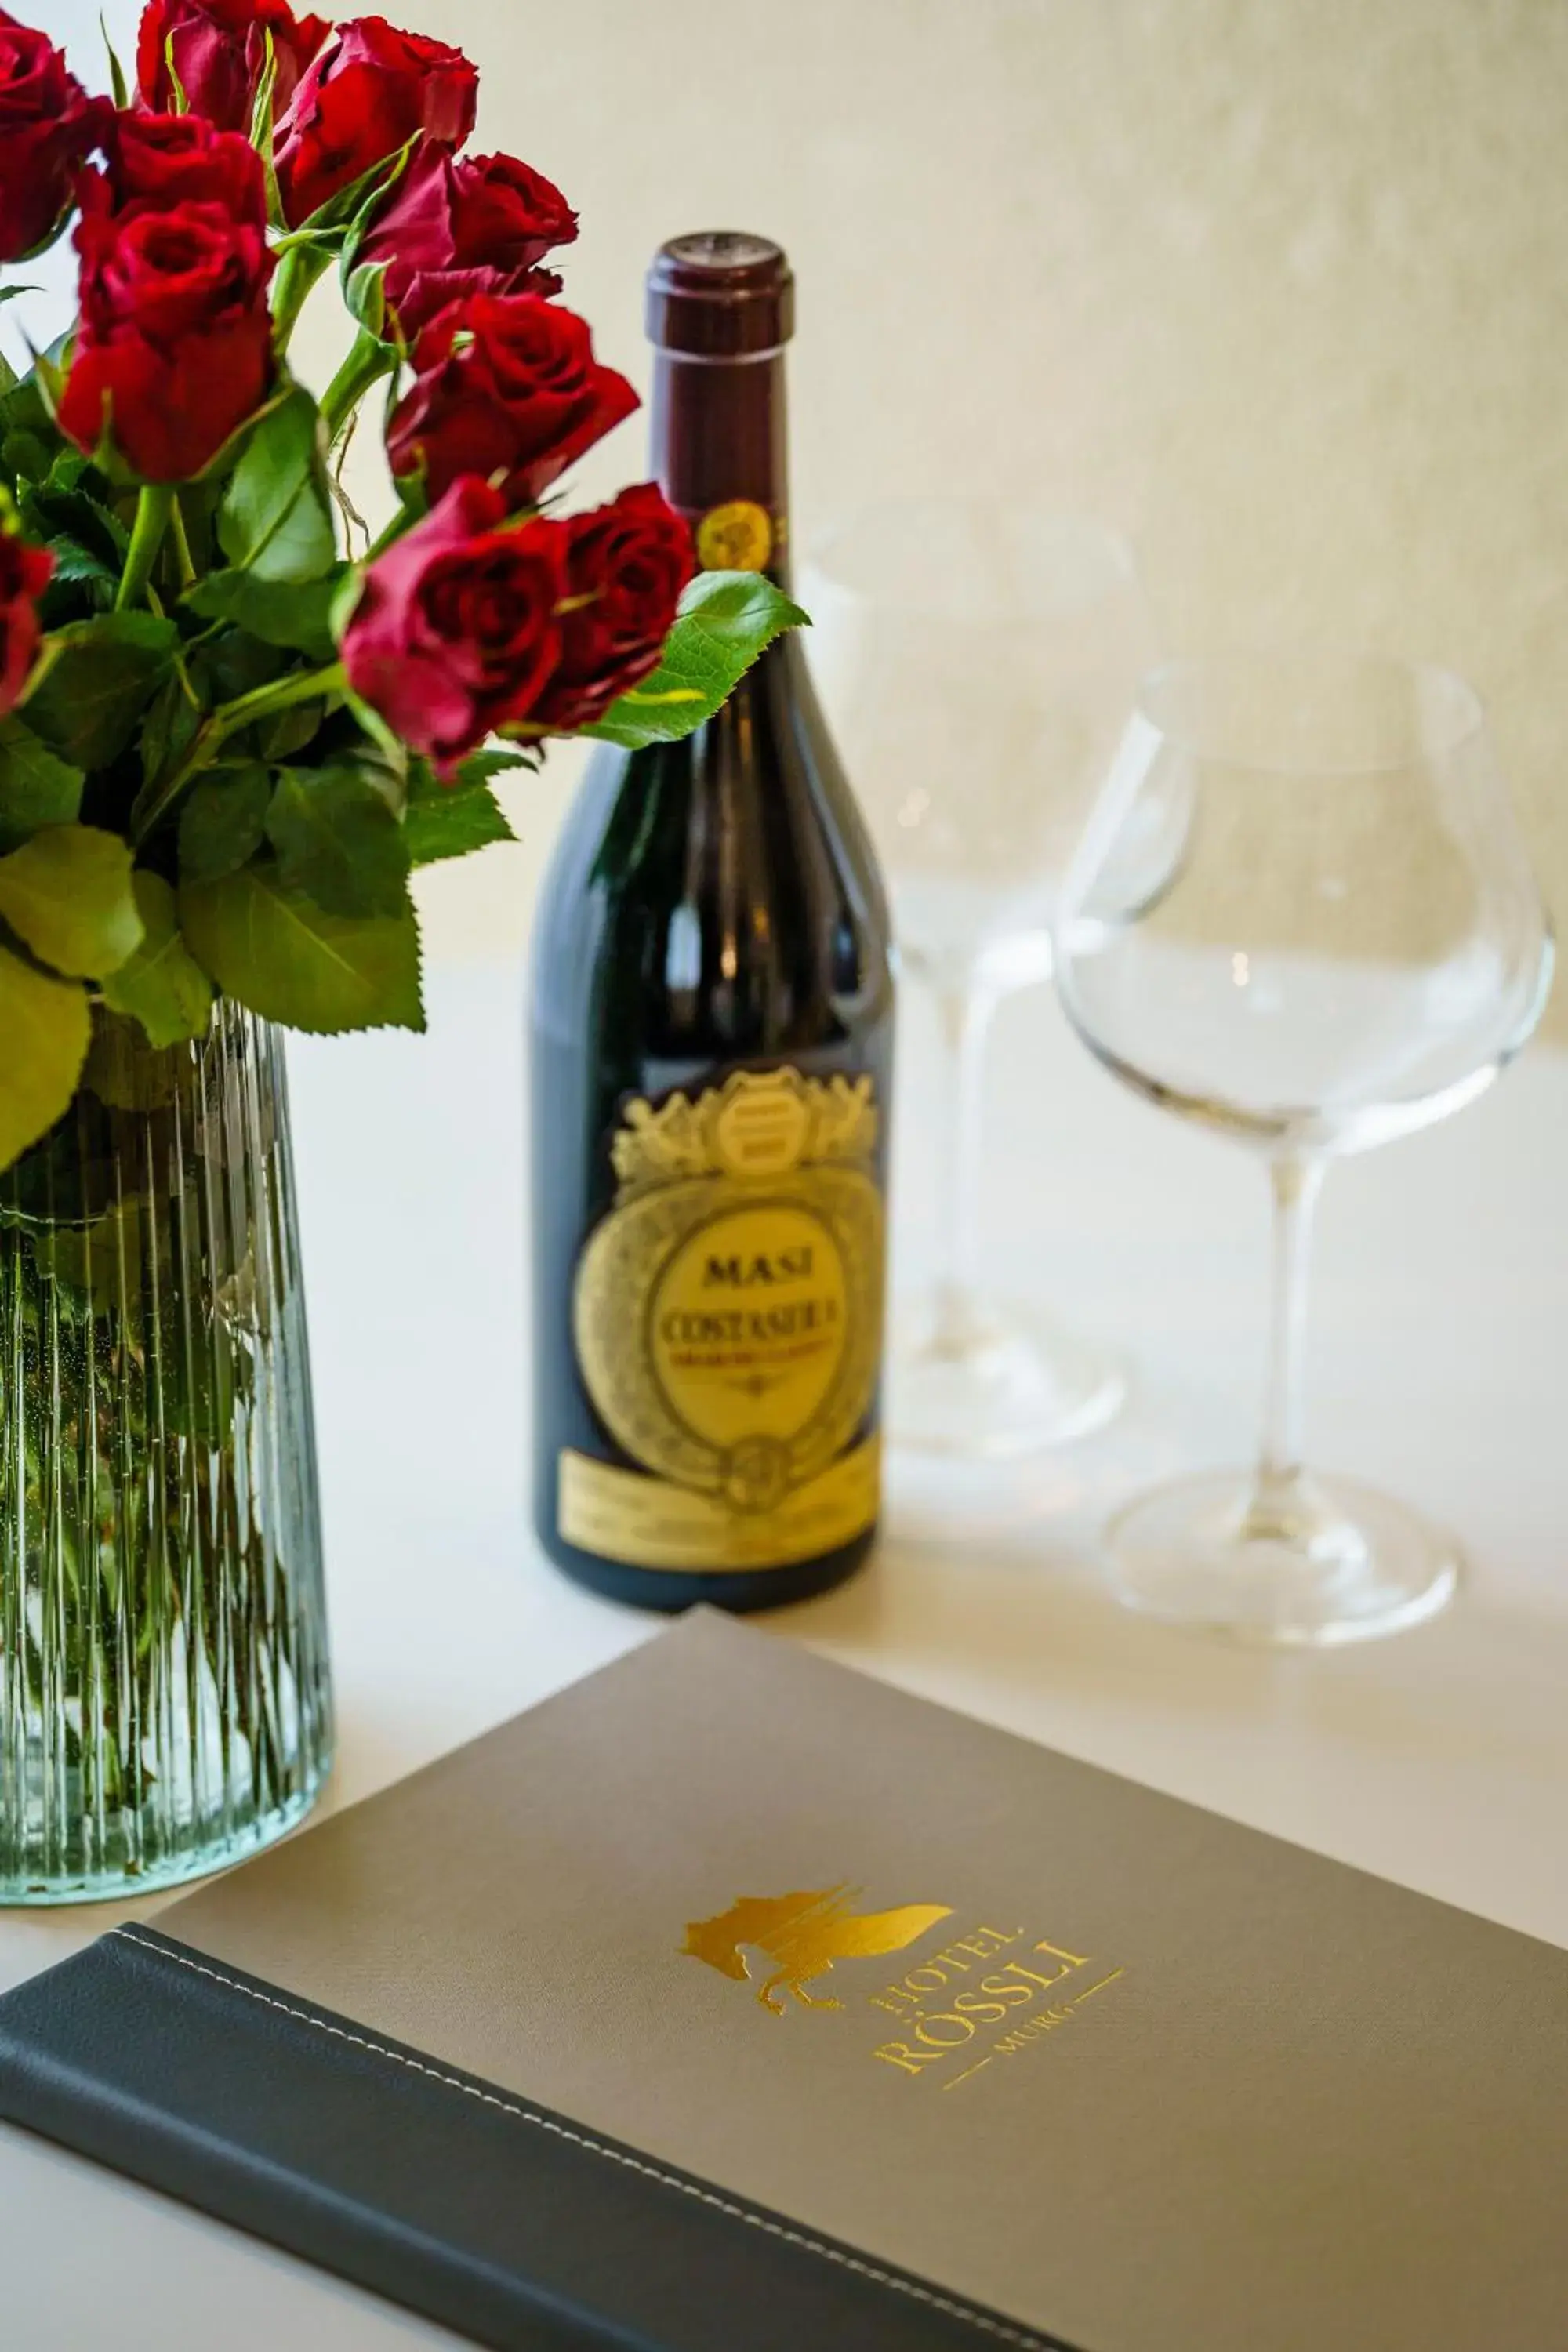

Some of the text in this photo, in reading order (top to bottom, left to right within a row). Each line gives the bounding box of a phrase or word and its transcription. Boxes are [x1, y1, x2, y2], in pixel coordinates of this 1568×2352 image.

[702, 1247, 814, 1289] MASI
[869, 1926, 1025, 2023] HOTEL
[873, 1940, 1091, 2075] RÖSSLI
